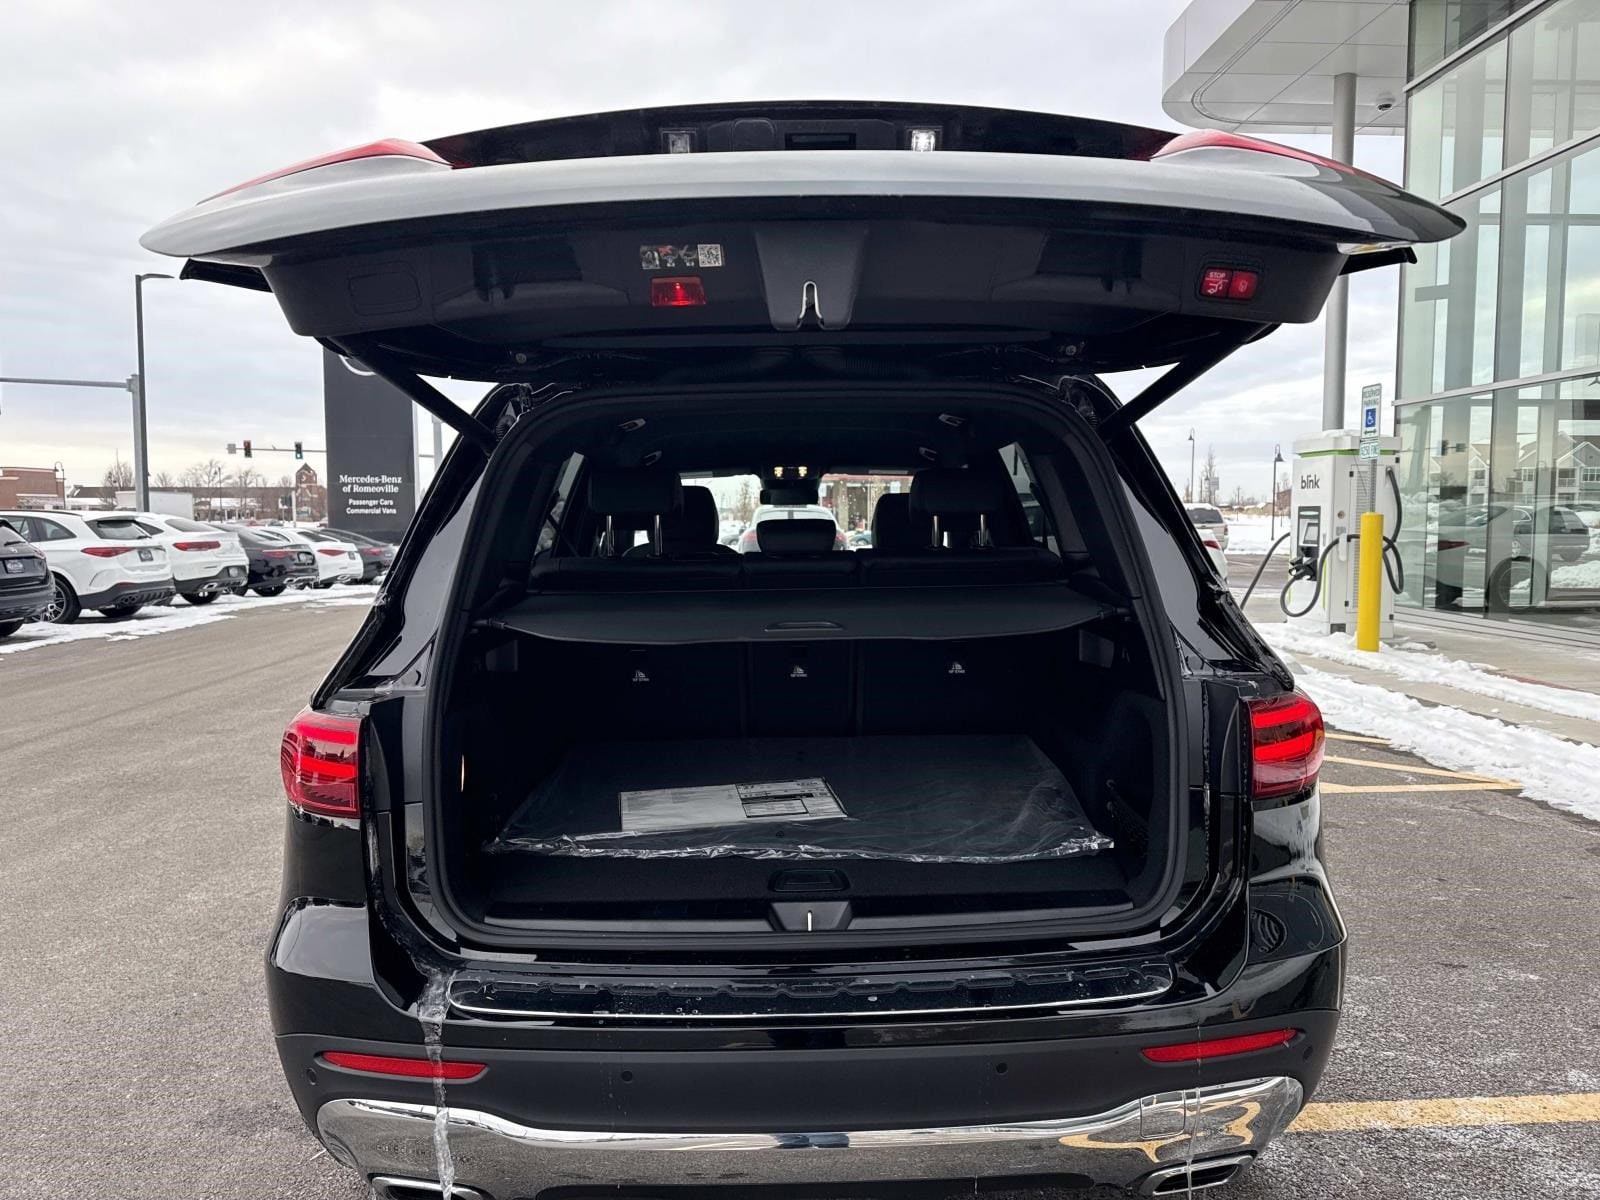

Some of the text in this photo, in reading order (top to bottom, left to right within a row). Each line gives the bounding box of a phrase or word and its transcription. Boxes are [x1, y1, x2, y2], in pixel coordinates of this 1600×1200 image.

[339, 475, 402, 483] Mercedes-Benz
[1300, 474, 1320, 489] blink
[342, 484, 399, 492] of Romeoville
[348, 498, 379, 506] Passenger
